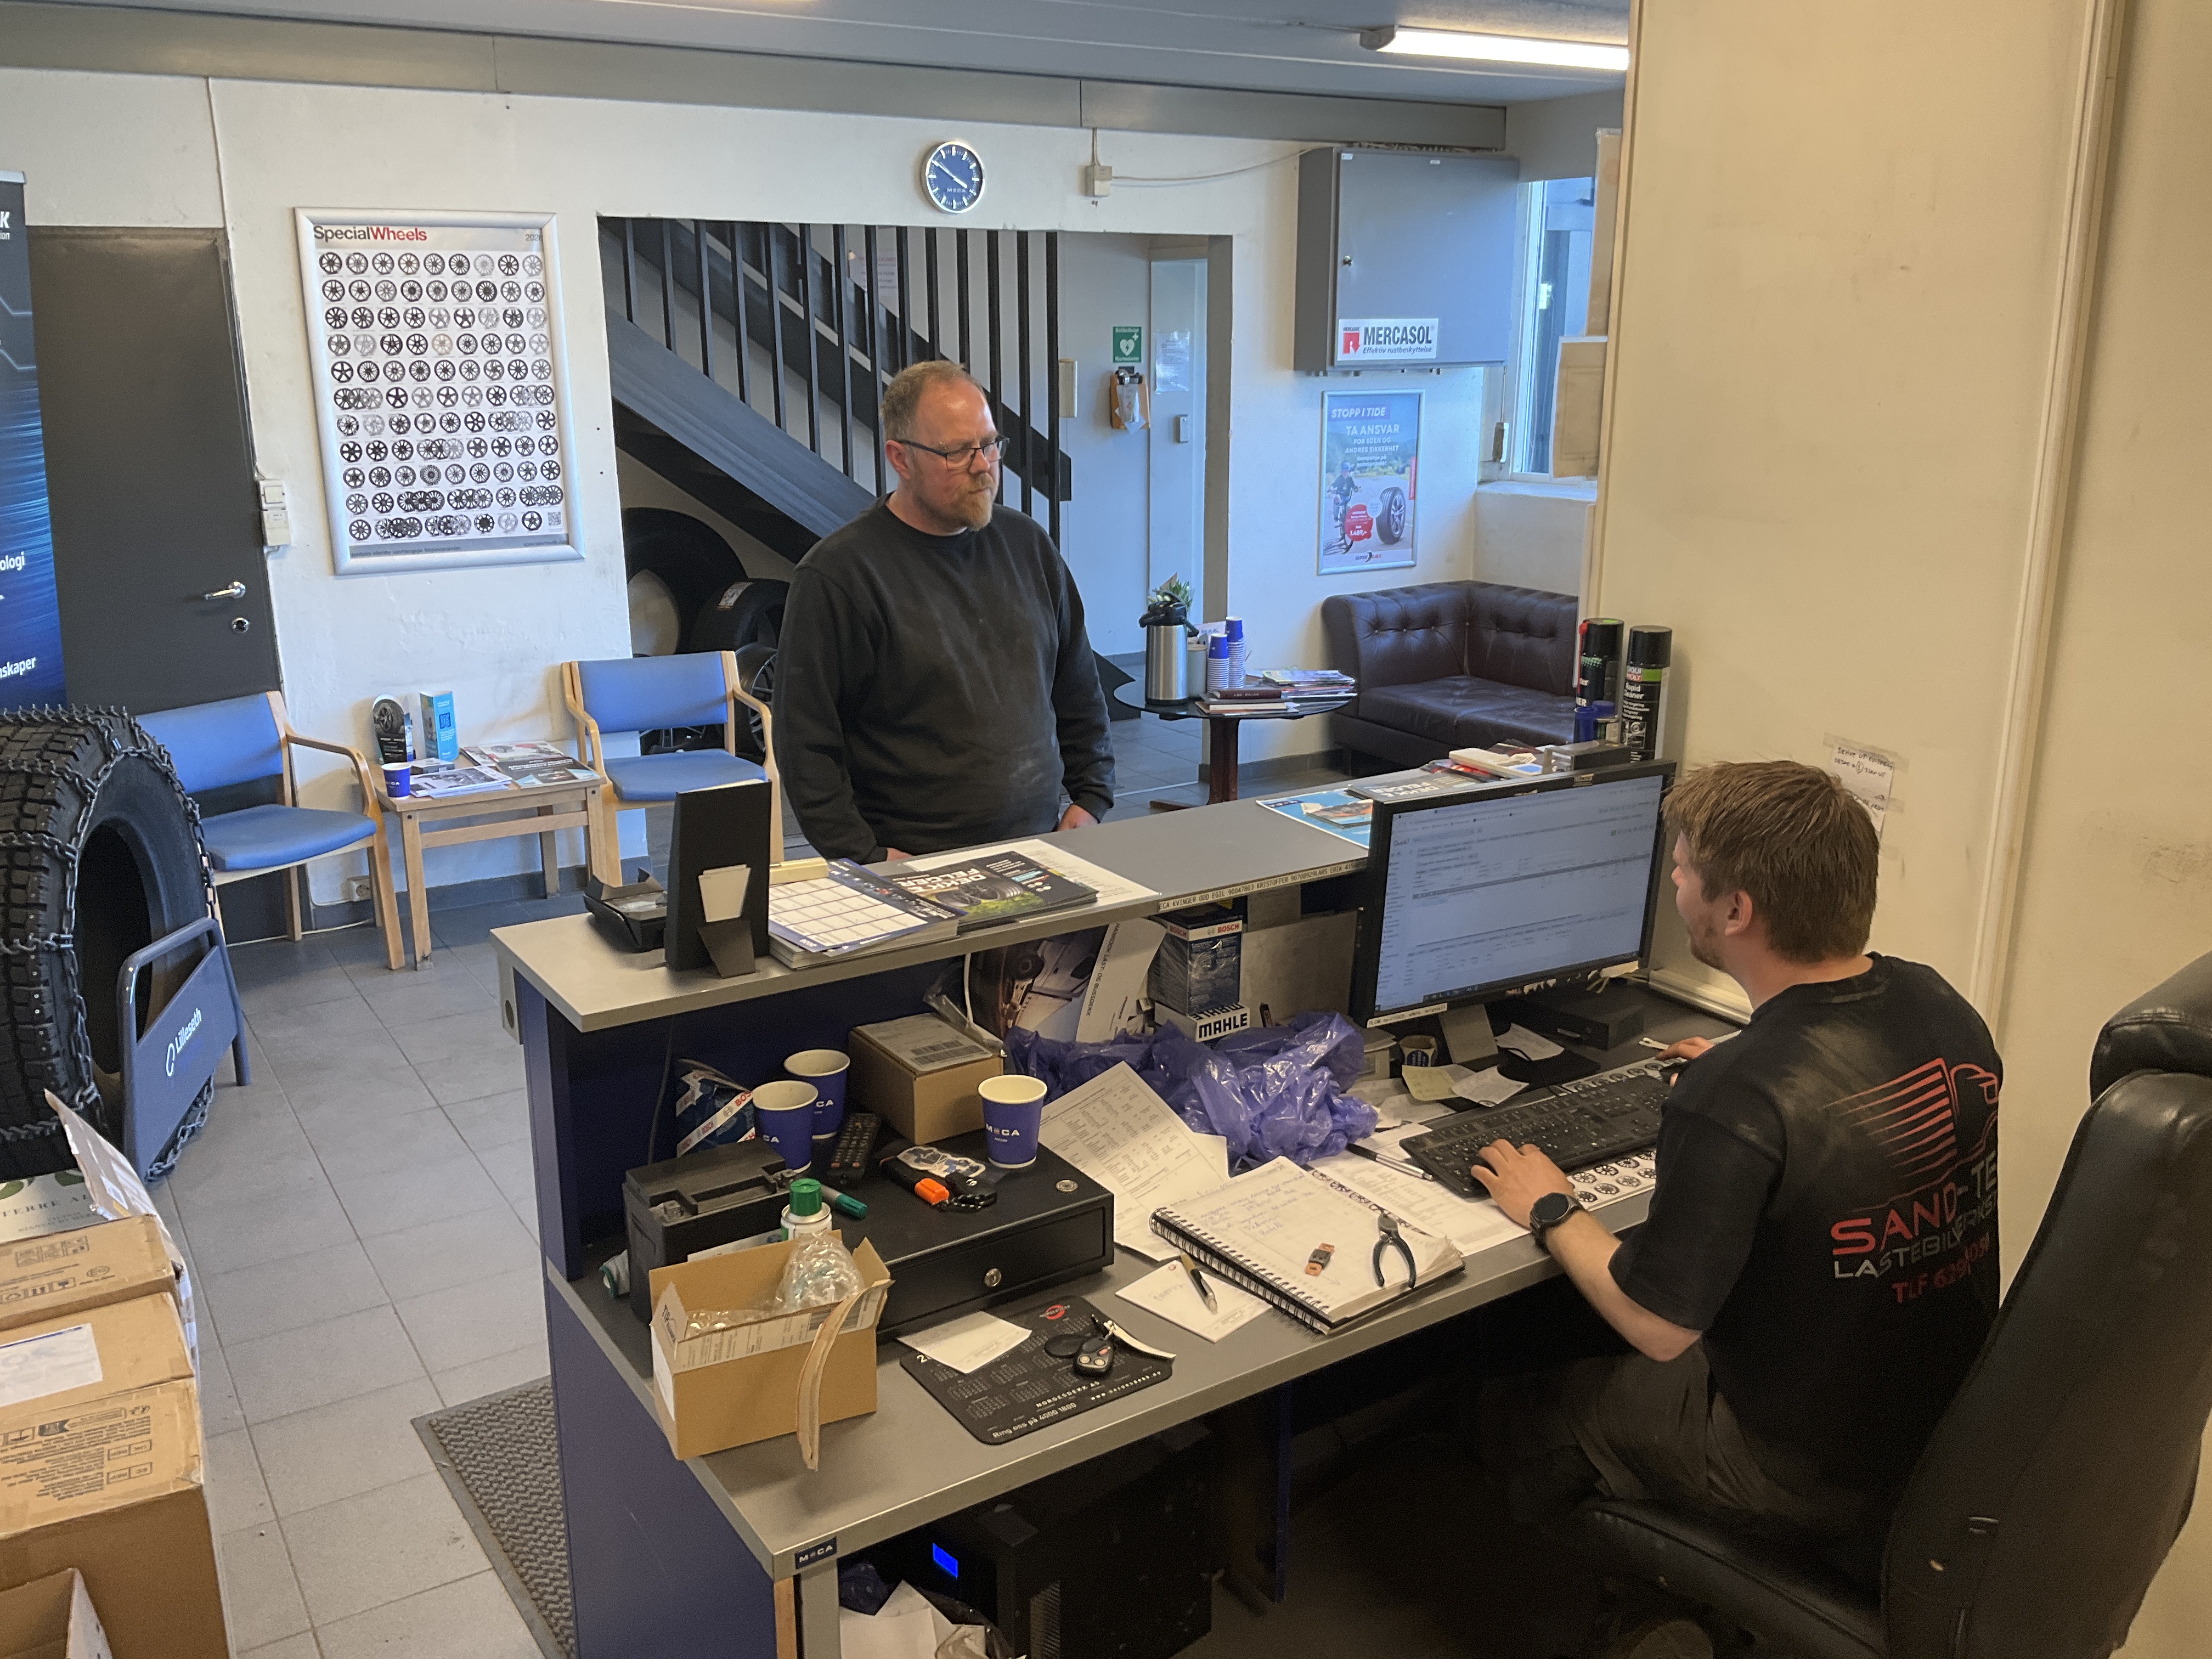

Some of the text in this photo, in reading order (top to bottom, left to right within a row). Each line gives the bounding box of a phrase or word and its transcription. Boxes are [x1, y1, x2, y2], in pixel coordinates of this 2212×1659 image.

[313, 225, 427, 242] SpecialWheels
[1363, 326, 1432, 346] MERCASOL
[1387, 346, 1431, 354] rustbeskyttelse
[1331, 407, 1386, 418] STOPP I TIDE
[1346, 424, 1400, 436] TA ANSVAR
[1626, 682, 1641, 692] Rapid
[897, 868, 980, 887] FELGER
[927, 874, 986, 890] DEKK
[1172, 897, 1197, 906] KVINGER
[1228, 885, 1255, 895] 90047803
[1256, 877, 1288, 889] KRISTOFFER
[1330, 865, 1342, 873] ERIK
[1170, 925, 1187, 938] BOSCH
[1217, 923, 1239, 933] BOSCH
[1096, 973, 1103, 982] OG
[175, 1008, 201, 1053] Lilleseth
[1199, 1013, 1247, 1039] MAHLE
[986, 1123, 1019, 1137] MECA
[1892, 1273, 1929, 1304] TLF
[992, 1402, 1077, 1438] Ring oss på 4000 1800
